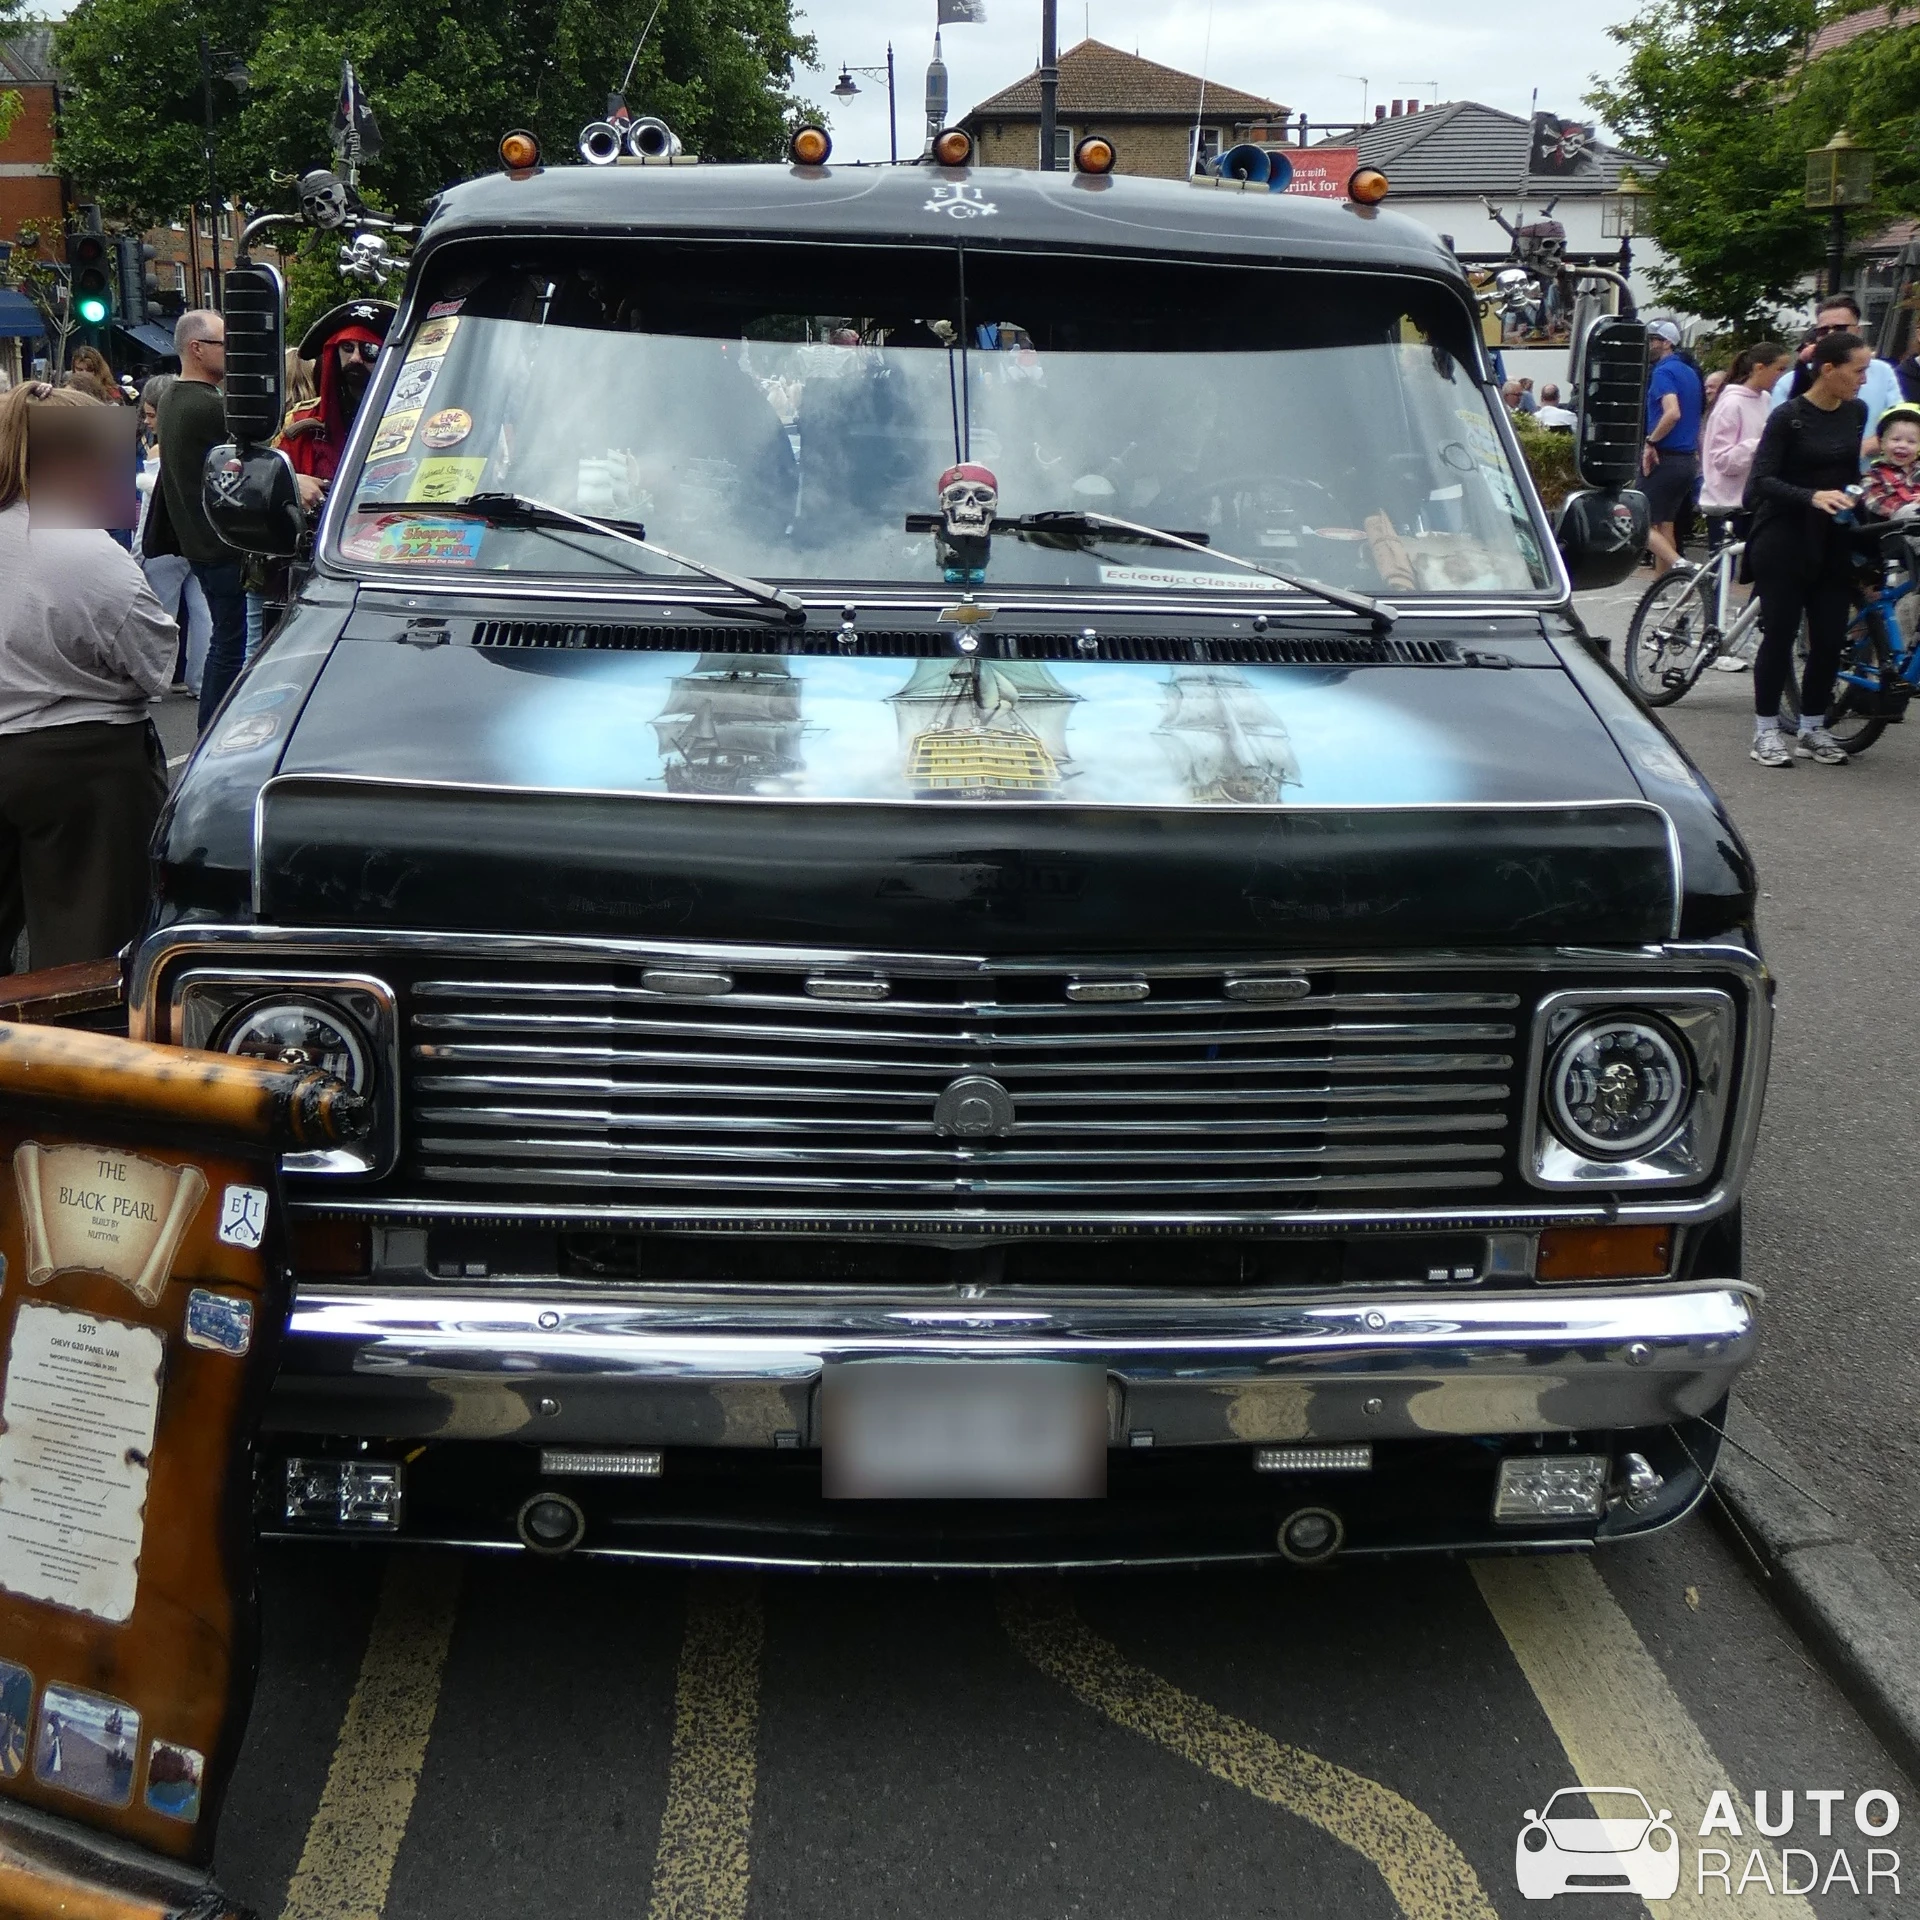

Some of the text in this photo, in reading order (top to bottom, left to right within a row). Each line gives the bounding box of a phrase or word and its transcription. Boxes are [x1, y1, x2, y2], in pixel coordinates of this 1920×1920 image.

[1307, 168, 1327, 177] with
[1284, 180, 1338, 193] rink for
[379, 542, 432, 559] 92.2
[432, 545, 474, 557] FM
[1106, 570, 1187, 584] Eclectic
[1192, 576, 1266, 590] Classic
[97, 1160, 127, 1182] THE
[59, 1186, 158, 1222] BLACK PEARL
[91, 1216, 120, 1229] BUILT BY
[77, 1323, 97, 1335] 1975
[50, 1337, 120, 1358] CHEVY G20 PANEL VAN
